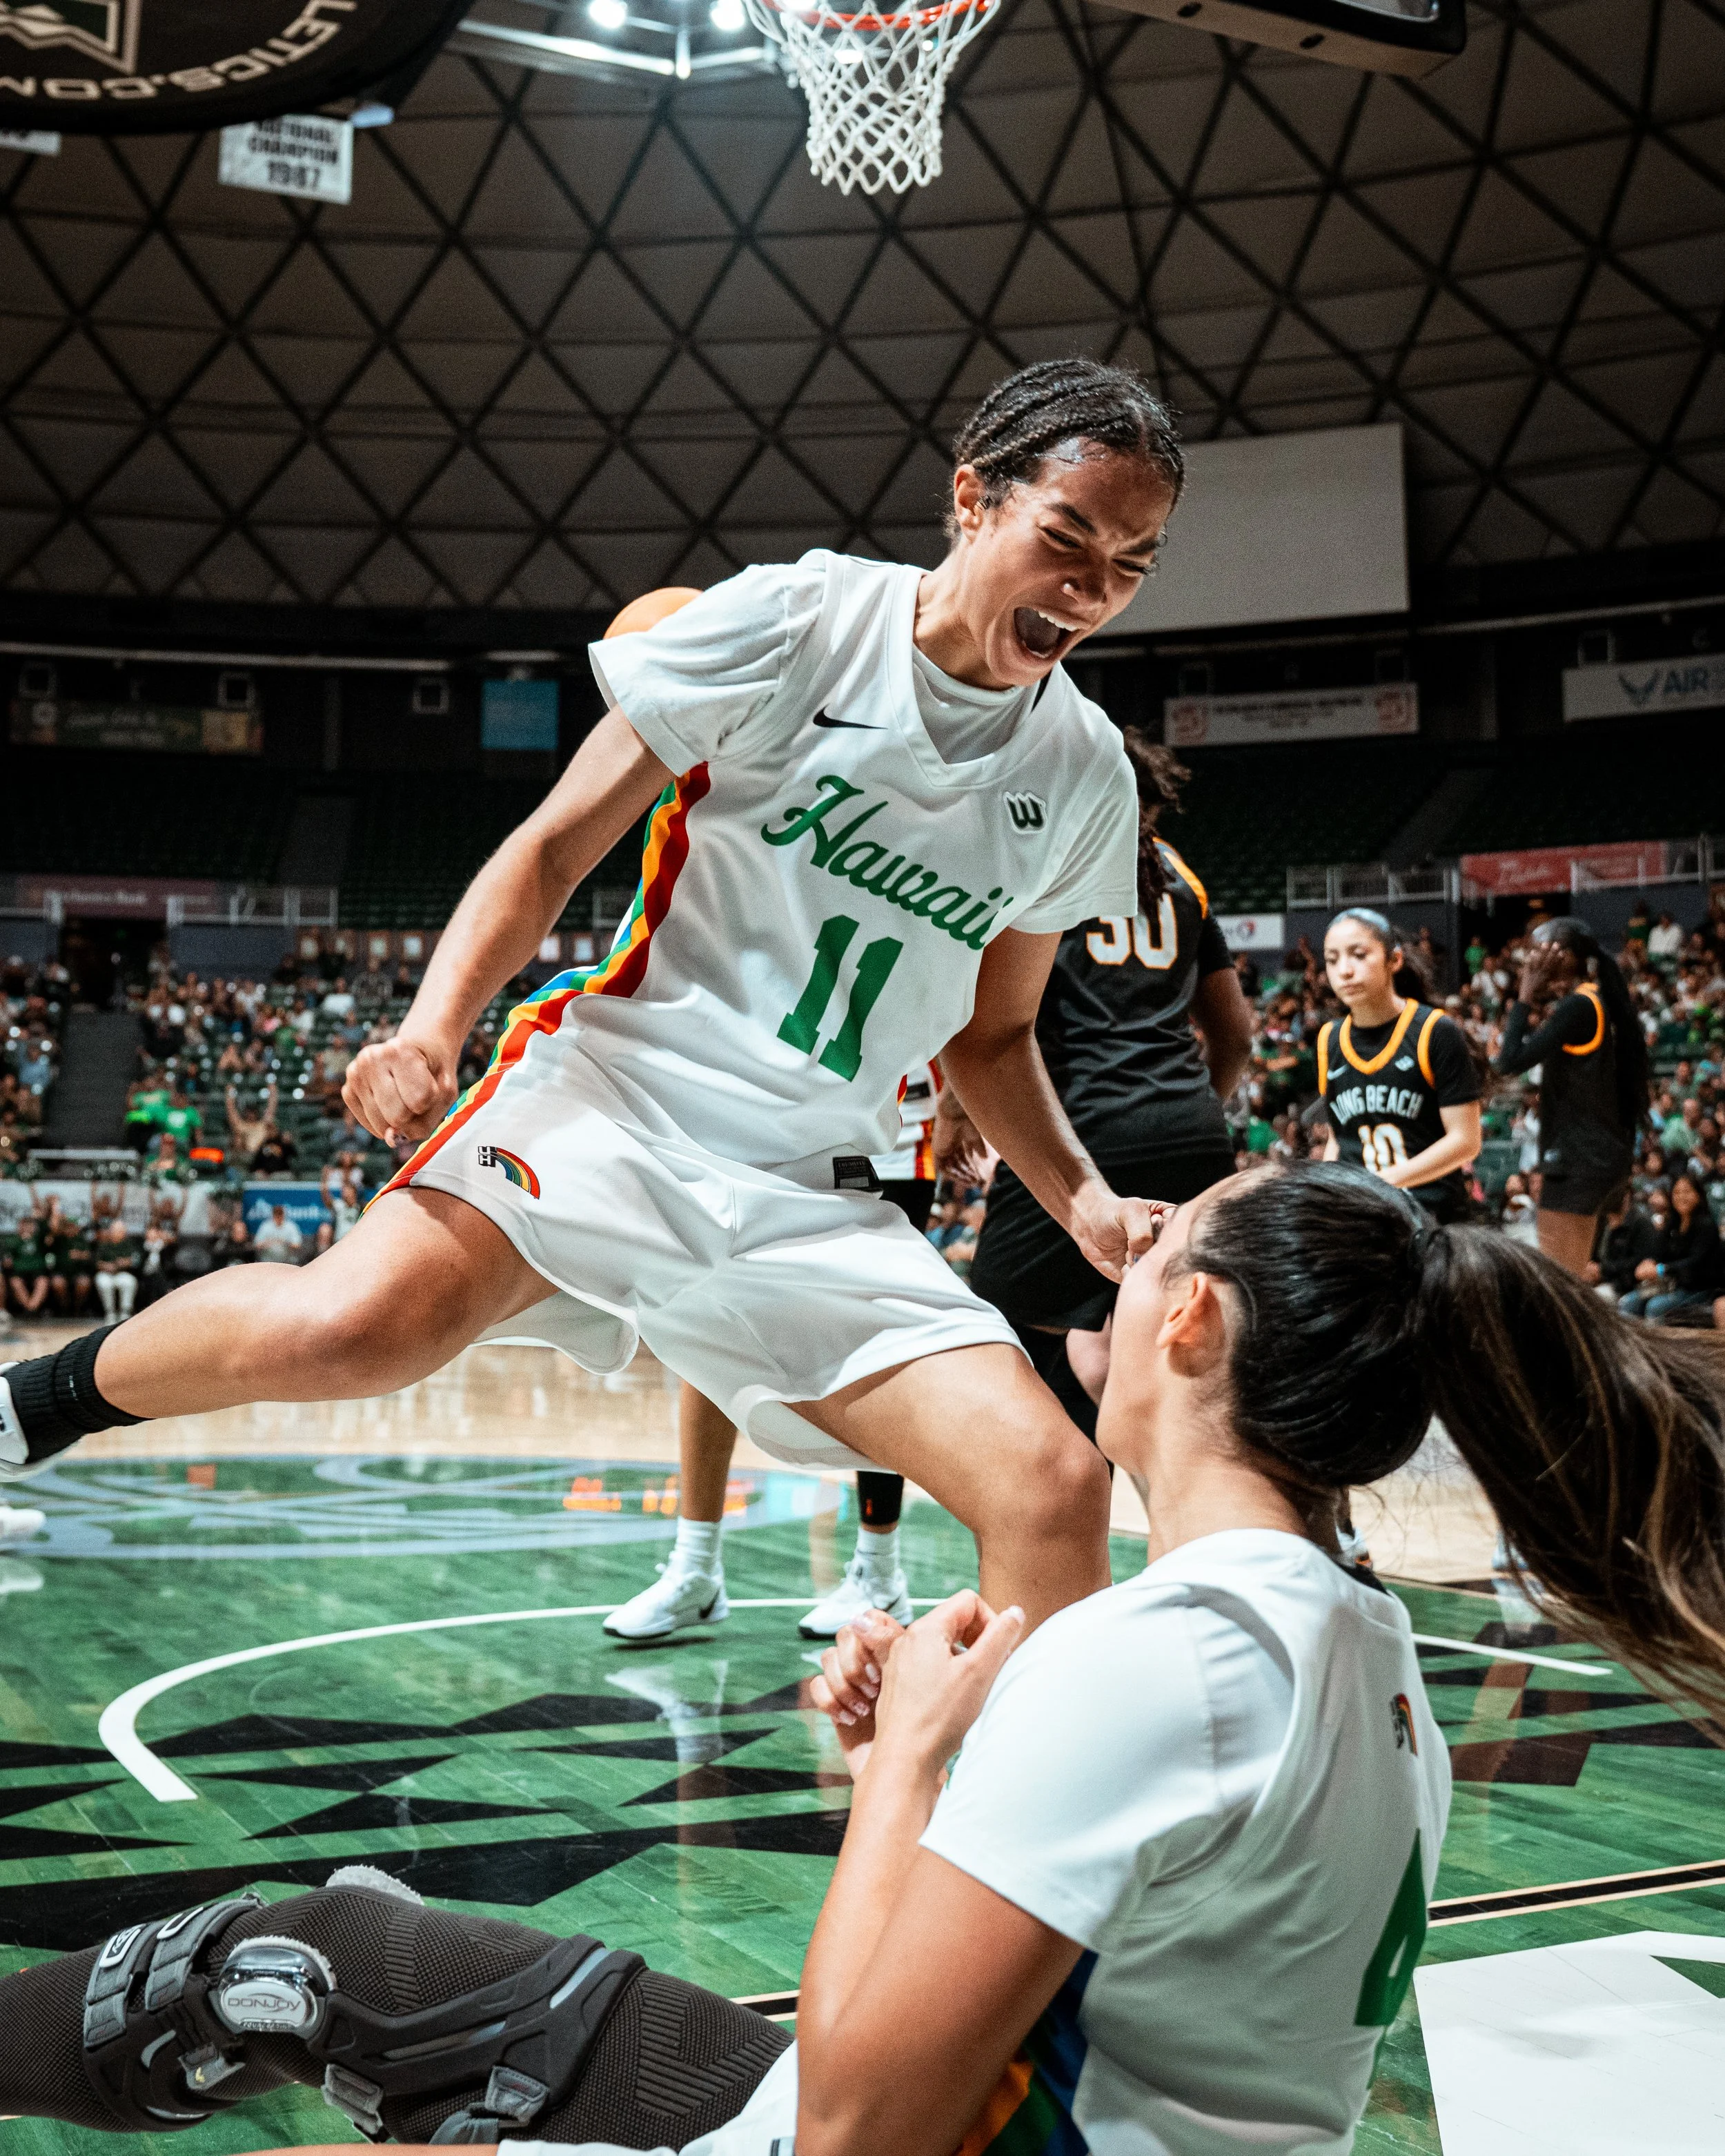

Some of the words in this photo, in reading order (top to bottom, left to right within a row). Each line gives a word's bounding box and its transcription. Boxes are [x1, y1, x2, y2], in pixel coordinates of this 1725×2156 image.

[1664, 666, 1709, 695] AIR
[776, 915, 904, 1082] 11
[1365, 1084, 1424, 1120] BEACH
[1358, 1122, 1410, 1174] 10
[227, 1997, 302, 2012] DONJOY
